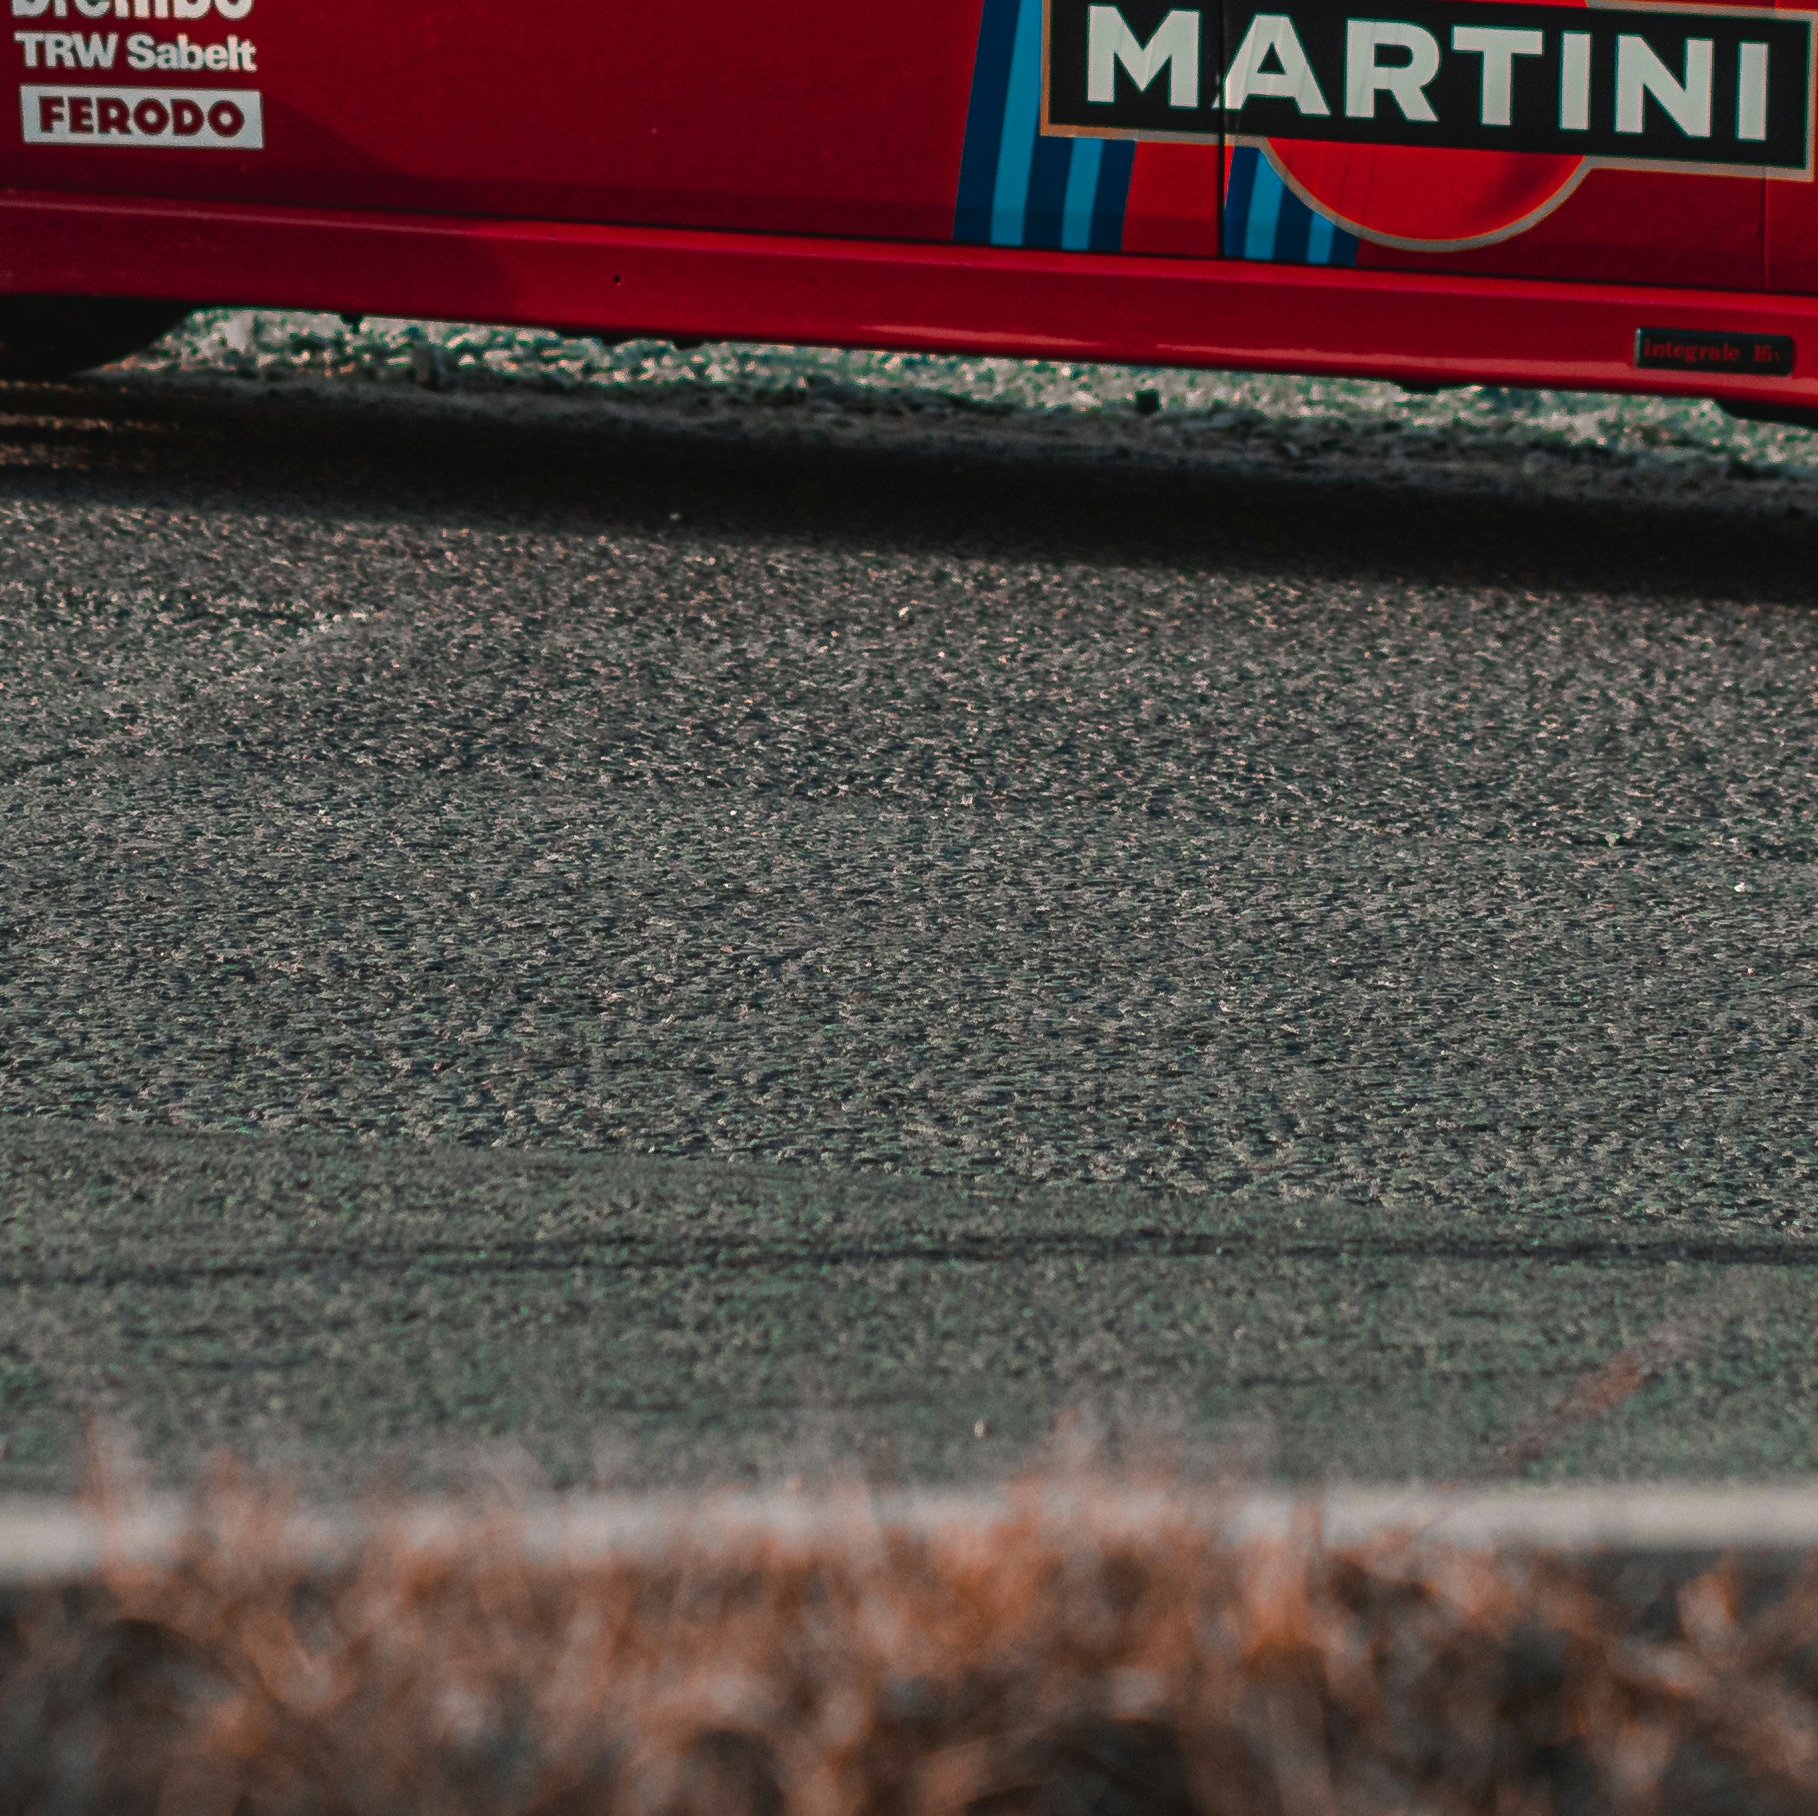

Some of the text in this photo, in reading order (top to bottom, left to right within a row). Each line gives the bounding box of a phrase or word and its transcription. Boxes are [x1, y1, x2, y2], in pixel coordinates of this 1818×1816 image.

[14, 31, 257, 72] TRW Sabelt
[1086, 4, 1768, 141] MARTINI
[38, 95, 245, 138] FERODO
[1643, 337, 1741, 364] integrale
